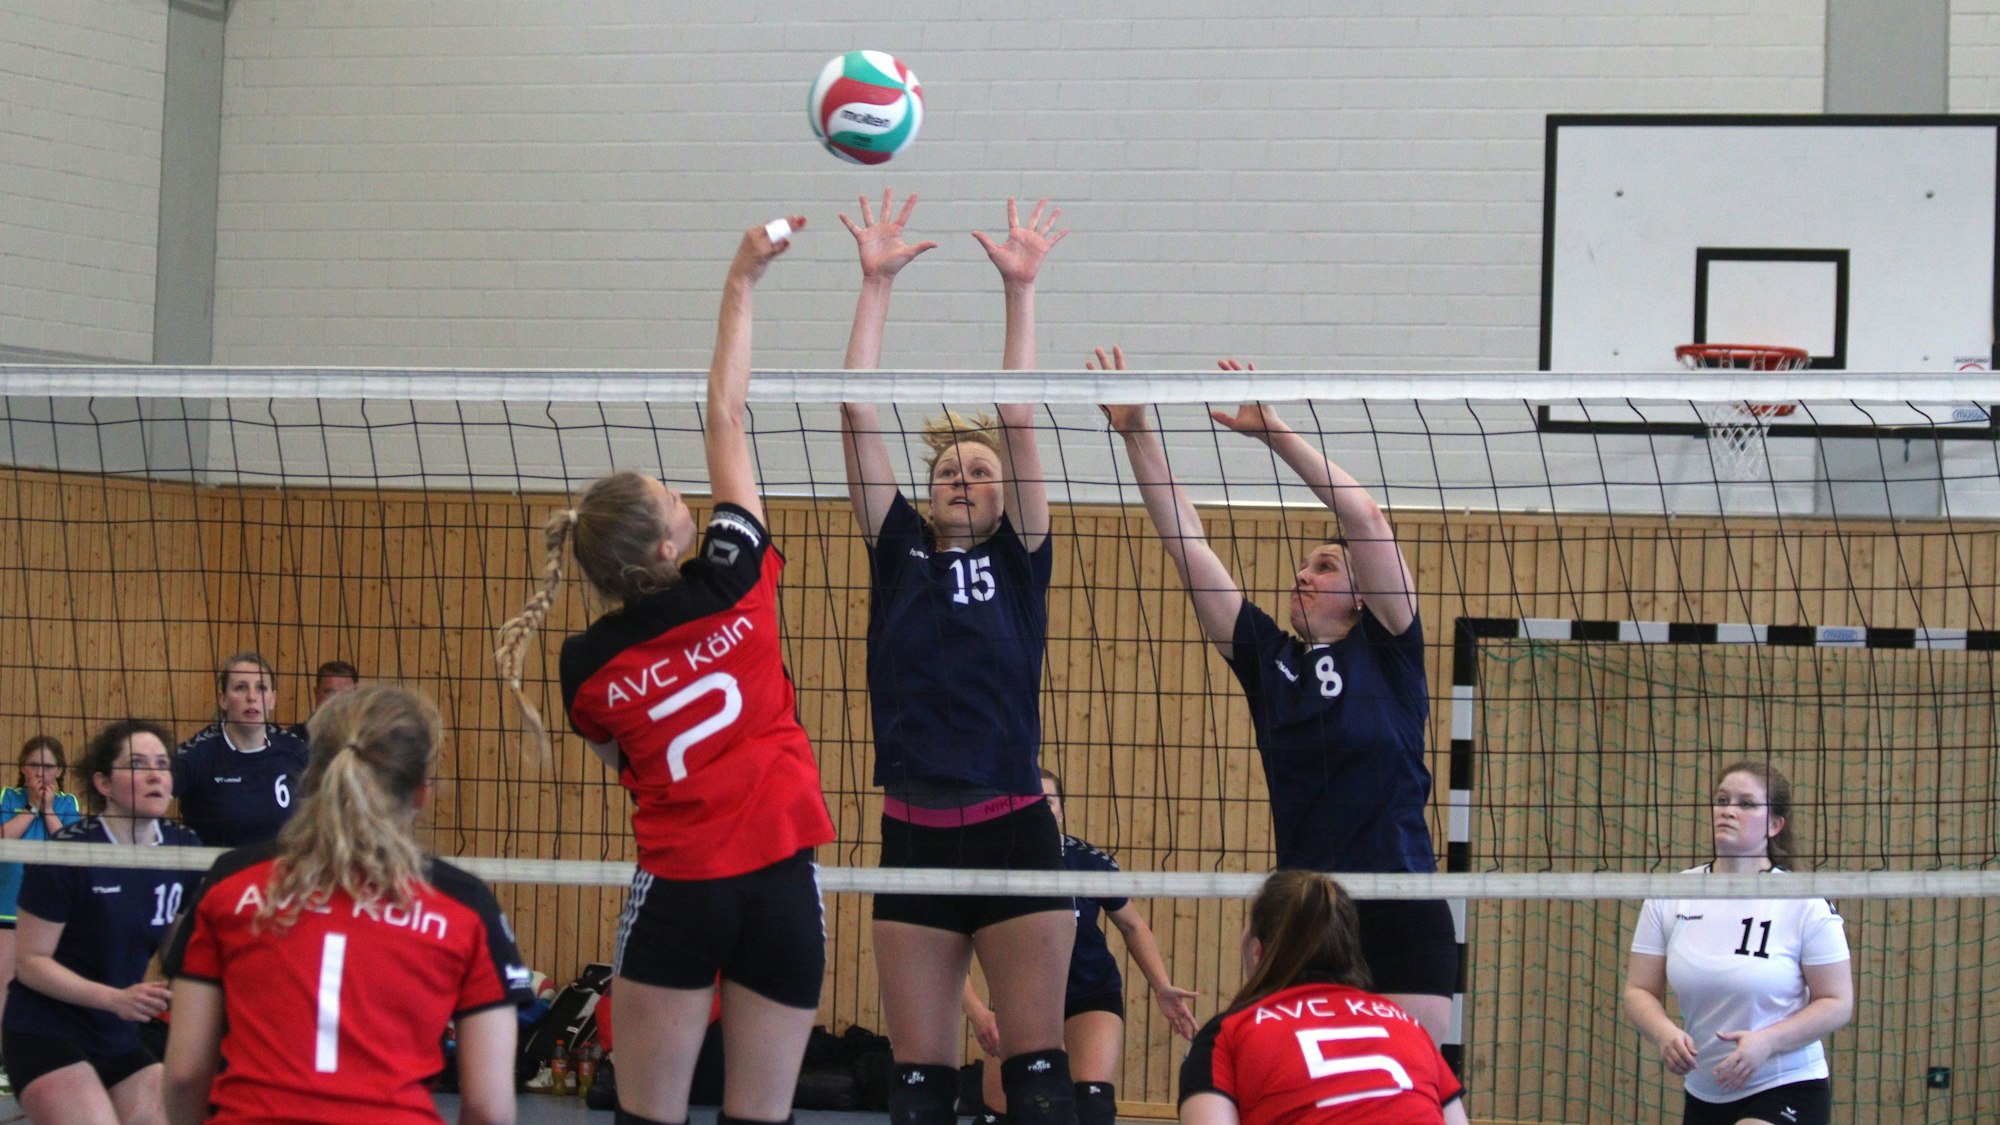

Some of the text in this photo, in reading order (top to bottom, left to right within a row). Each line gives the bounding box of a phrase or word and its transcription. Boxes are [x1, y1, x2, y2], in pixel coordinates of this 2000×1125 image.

[949, 556, 995, 604] 15
[608, 616, 753, 708] AVC Köln
[1315, 655, 1343, 699] 8
[647, 671, 743, 782] 2
[275, 774, 290, 808] 6
[150, 883, 183, 926] 10
[1734, 917, 1772, 959] 11
[315, 932, 347, 1073] 1
[1256, 998, 1335, 1024] AVC
[1295, 1026, 1414, 1108] 5
